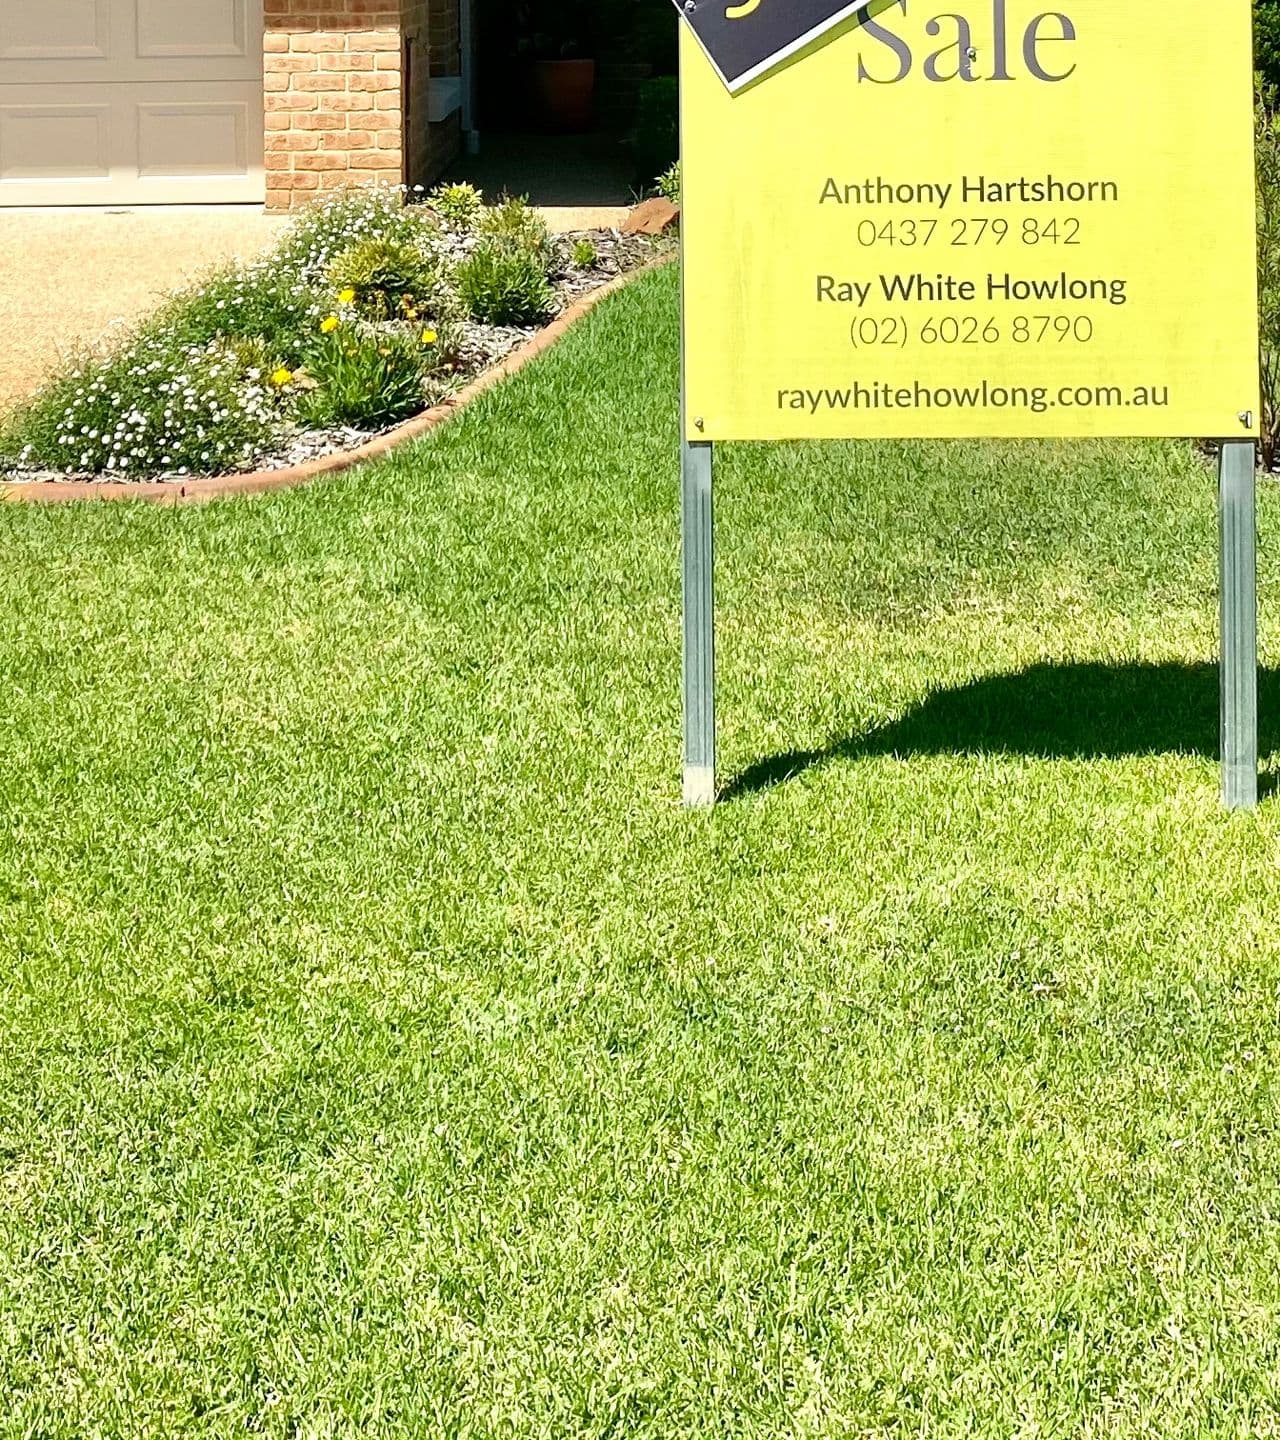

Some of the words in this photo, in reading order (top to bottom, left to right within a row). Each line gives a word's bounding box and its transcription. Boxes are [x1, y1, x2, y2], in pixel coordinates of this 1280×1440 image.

[819, 176, 952, 210] Anthony
[962, 174, 1119, 202] Hartshorn
[857, 219, 938, 247] 0437
[950, 218, 1009, 246] 279
[1021, 217, 1081, 245] 842
[816, 275, 872, 307] Ray
[879, 273, 976, 302] White
[986, 271, 1128, 306] Howlong
[850, 315, 908, 349] (02)
[920, 316, 1000, 344] 6026
[1011, 315, 1093, 344] 8790
[777, 379, 1169, 415] raywhitehowlong.com.au
